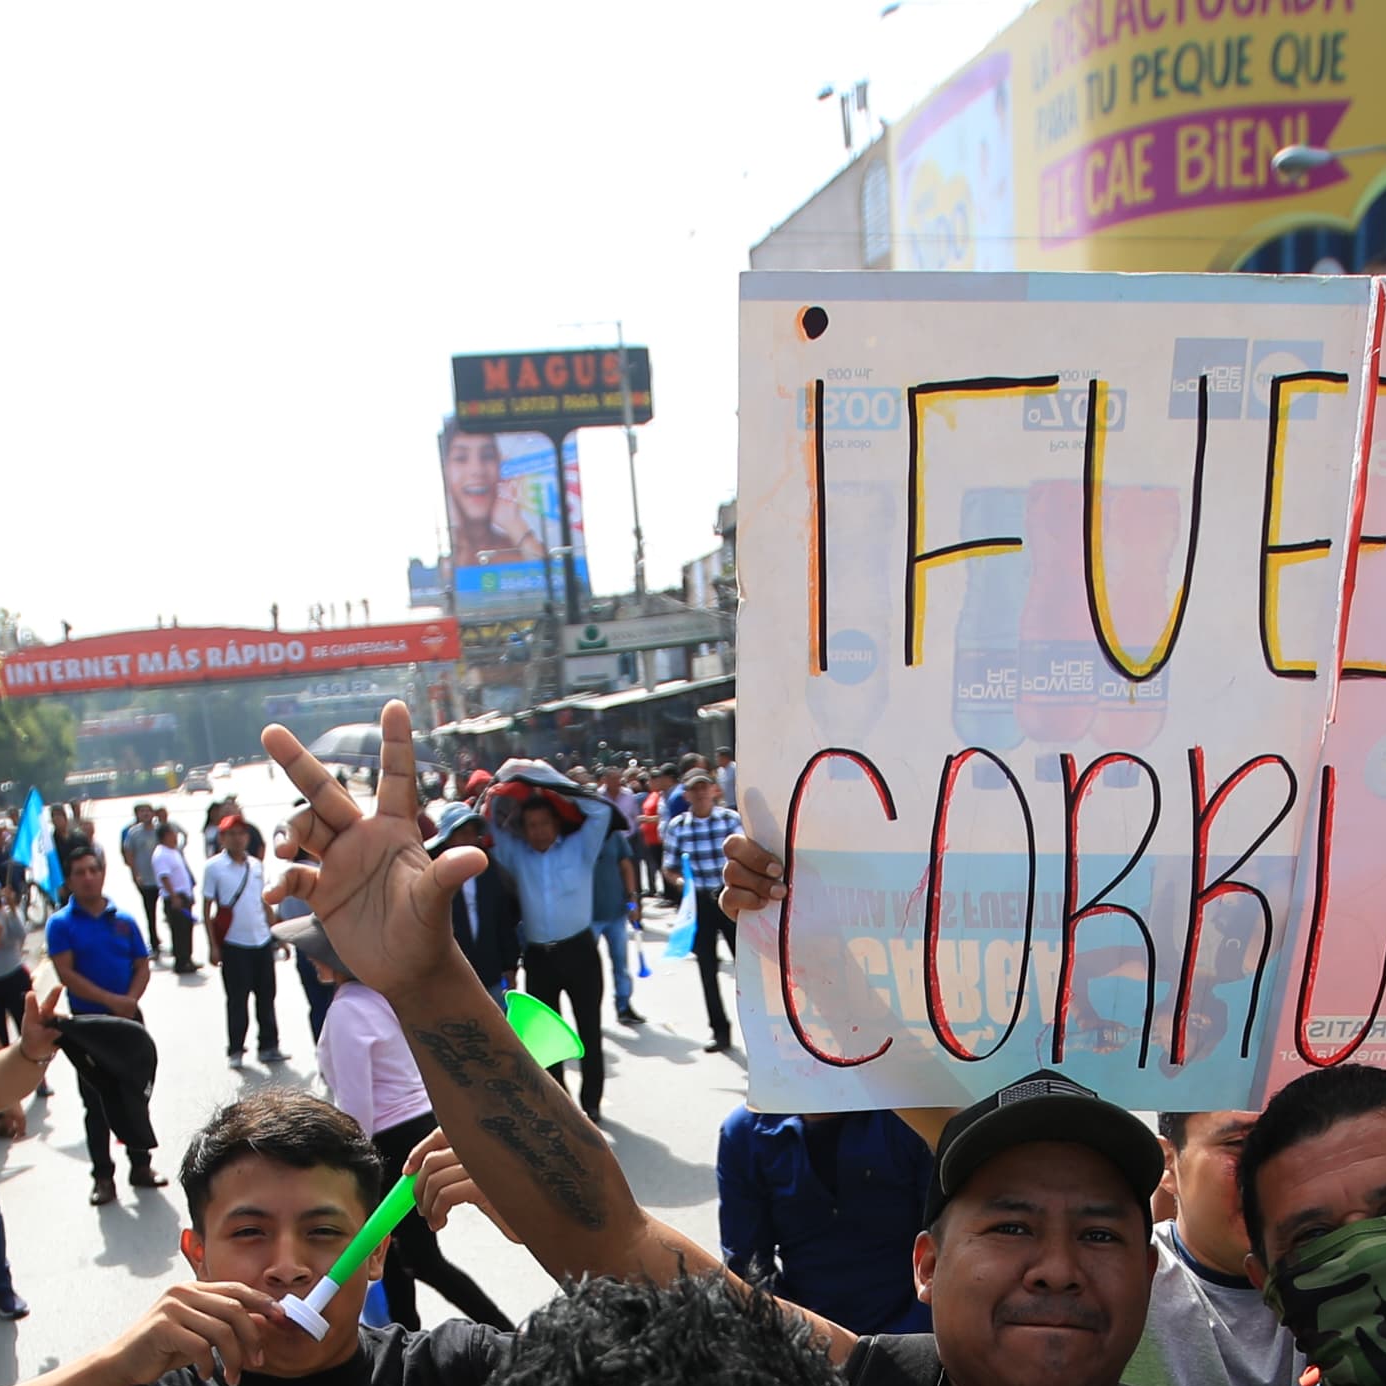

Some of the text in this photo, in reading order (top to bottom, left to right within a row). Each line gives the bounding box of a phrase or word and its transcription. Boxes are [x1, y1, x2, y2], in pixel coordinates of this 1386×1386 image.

[1086, 63, 1118, 120] TU
[1131, 35, 1253, 104] PEQUE
[1271, 30, 1348, 88] QUE
[1086, 134, 1156, 219] CAE
[481, 353, 623, 391] MAGUS
[5, 653, 132, 686] INTERNET
[137, 646, 201, 675] MÁS
[206, 639, 305, 668] RÁPIDO
[311, 644, 329, 659] DE
[330, 639, 408, 658] GUATEMALA
